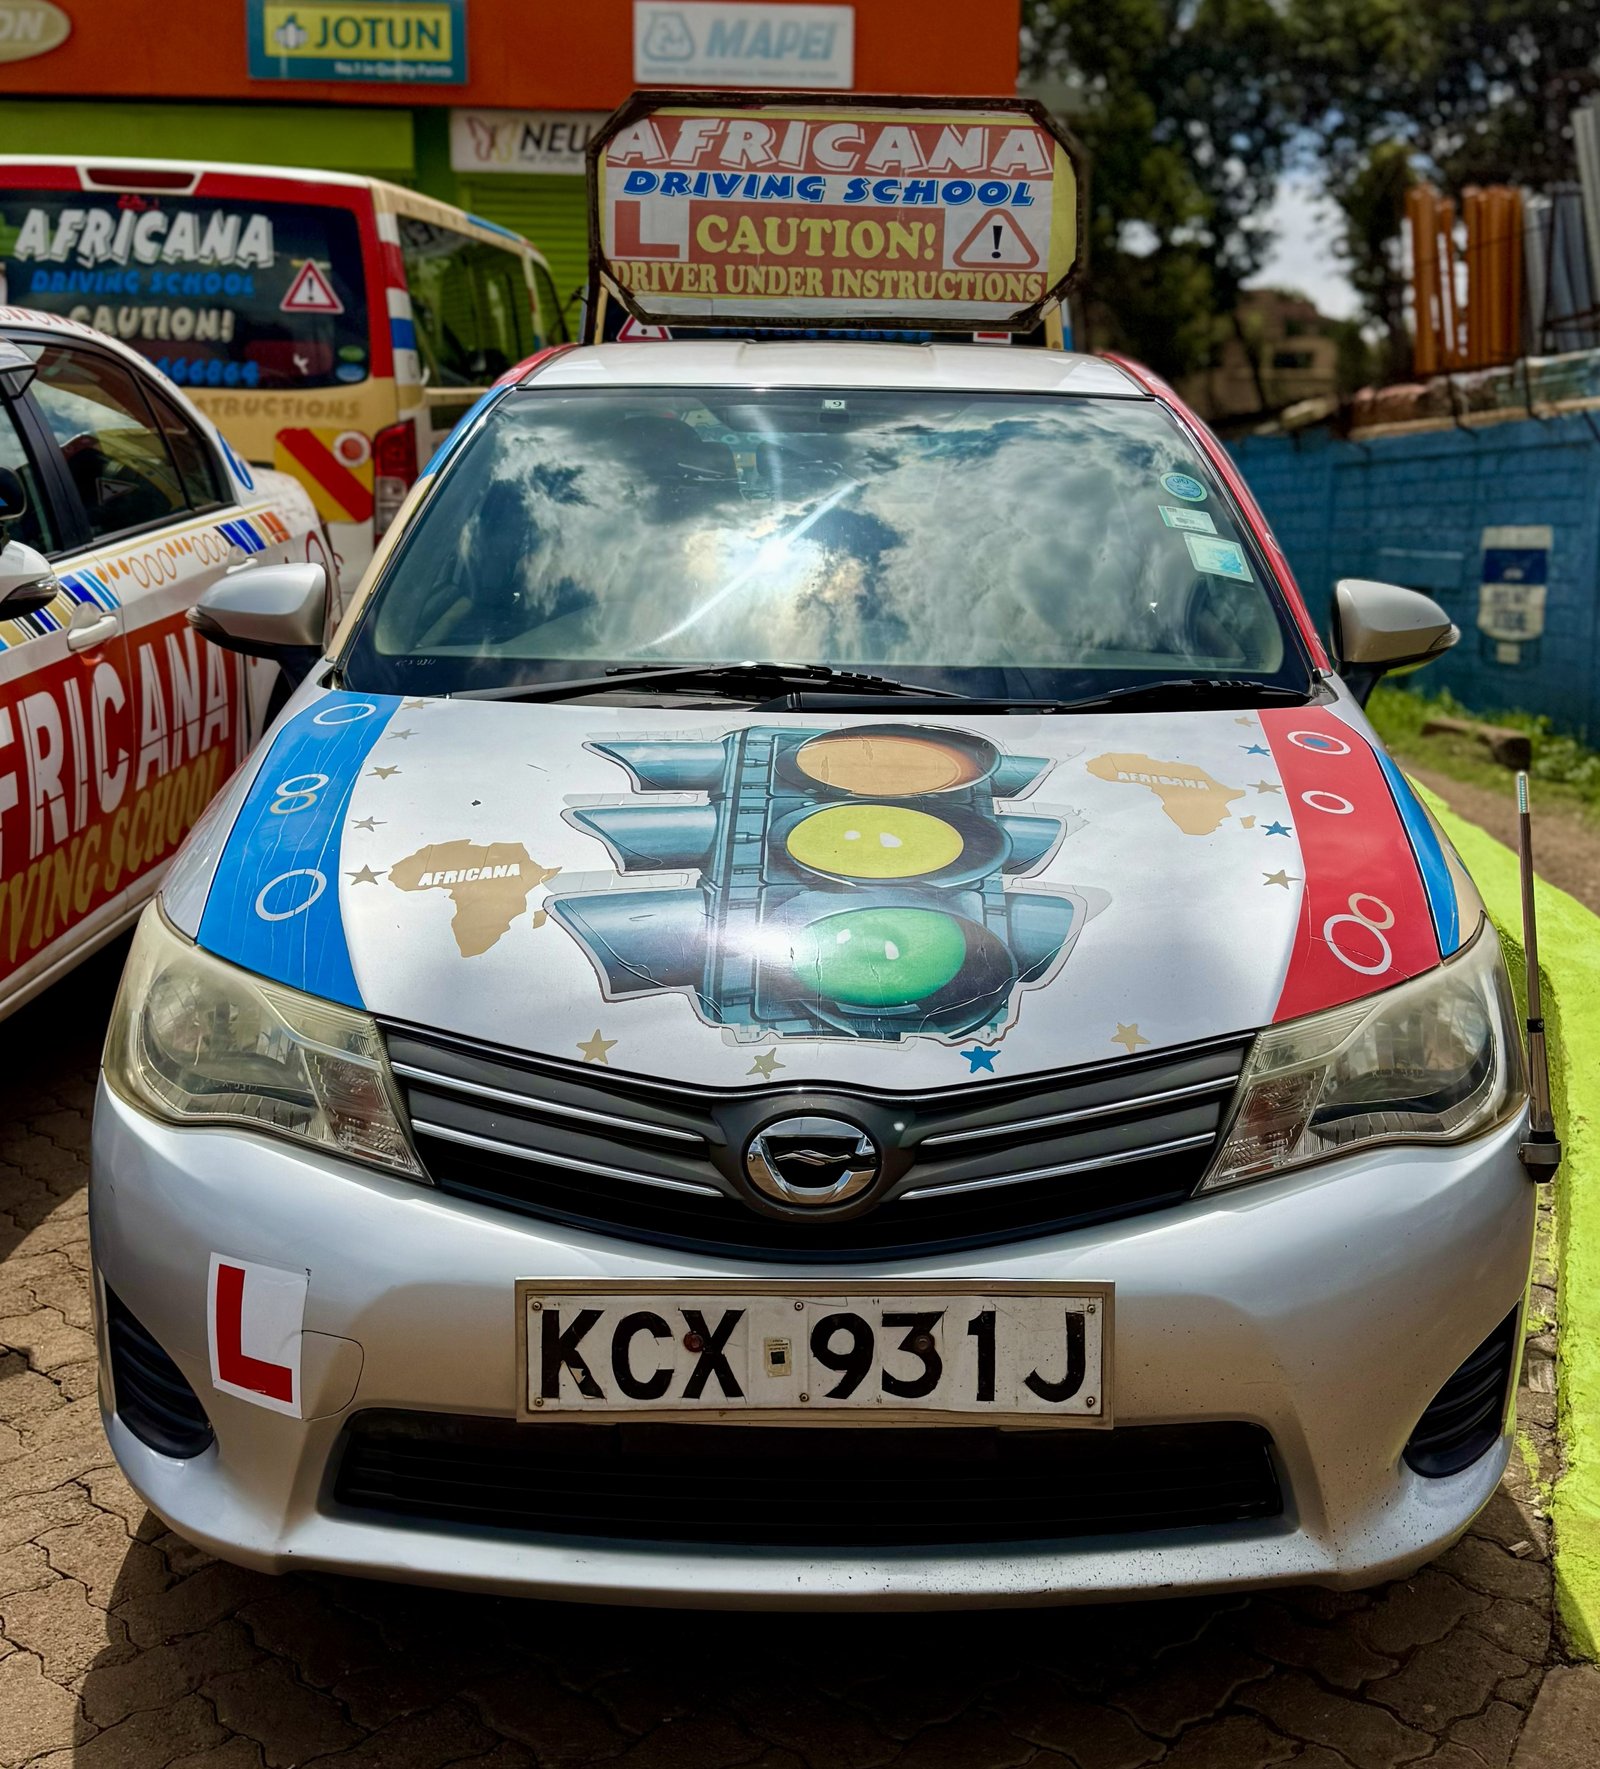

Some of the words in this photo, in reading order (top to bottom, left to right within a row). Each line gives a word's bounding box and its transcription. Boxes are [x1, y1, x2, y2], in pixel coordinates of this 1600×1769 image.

[315, 16, 441, 49] JOTUN
[706, 20, 839, 61] MAPEI
[606, 118, 1053, 177] AFRICANA
[622, 170, 827, 202] DRIVING
[843, 175, 1035, 206] SCHOOL
[14, 208, 275, 269] AFRICANA
[614, 200, 681, 258] L
[695, 214, 937, 260] CAUTION!
[31, 269, 141, 295] DRIVING
[149, 271, 255, 296] SCHOOL
[610, 260, 719, 294] DRIVER
[725, 264, 823, 297] UNDER
[830, 269, 1044, 302] INSTRUCTIONS
[1117, 771, 1210, 792] AFRICANA
[418, 863, 521, 887] AFRICANA
[216, 1263, 293, 1404] L
[540, 1308, 746, 1400] KCX
[809, 1310, 1087, 1403] 931J
